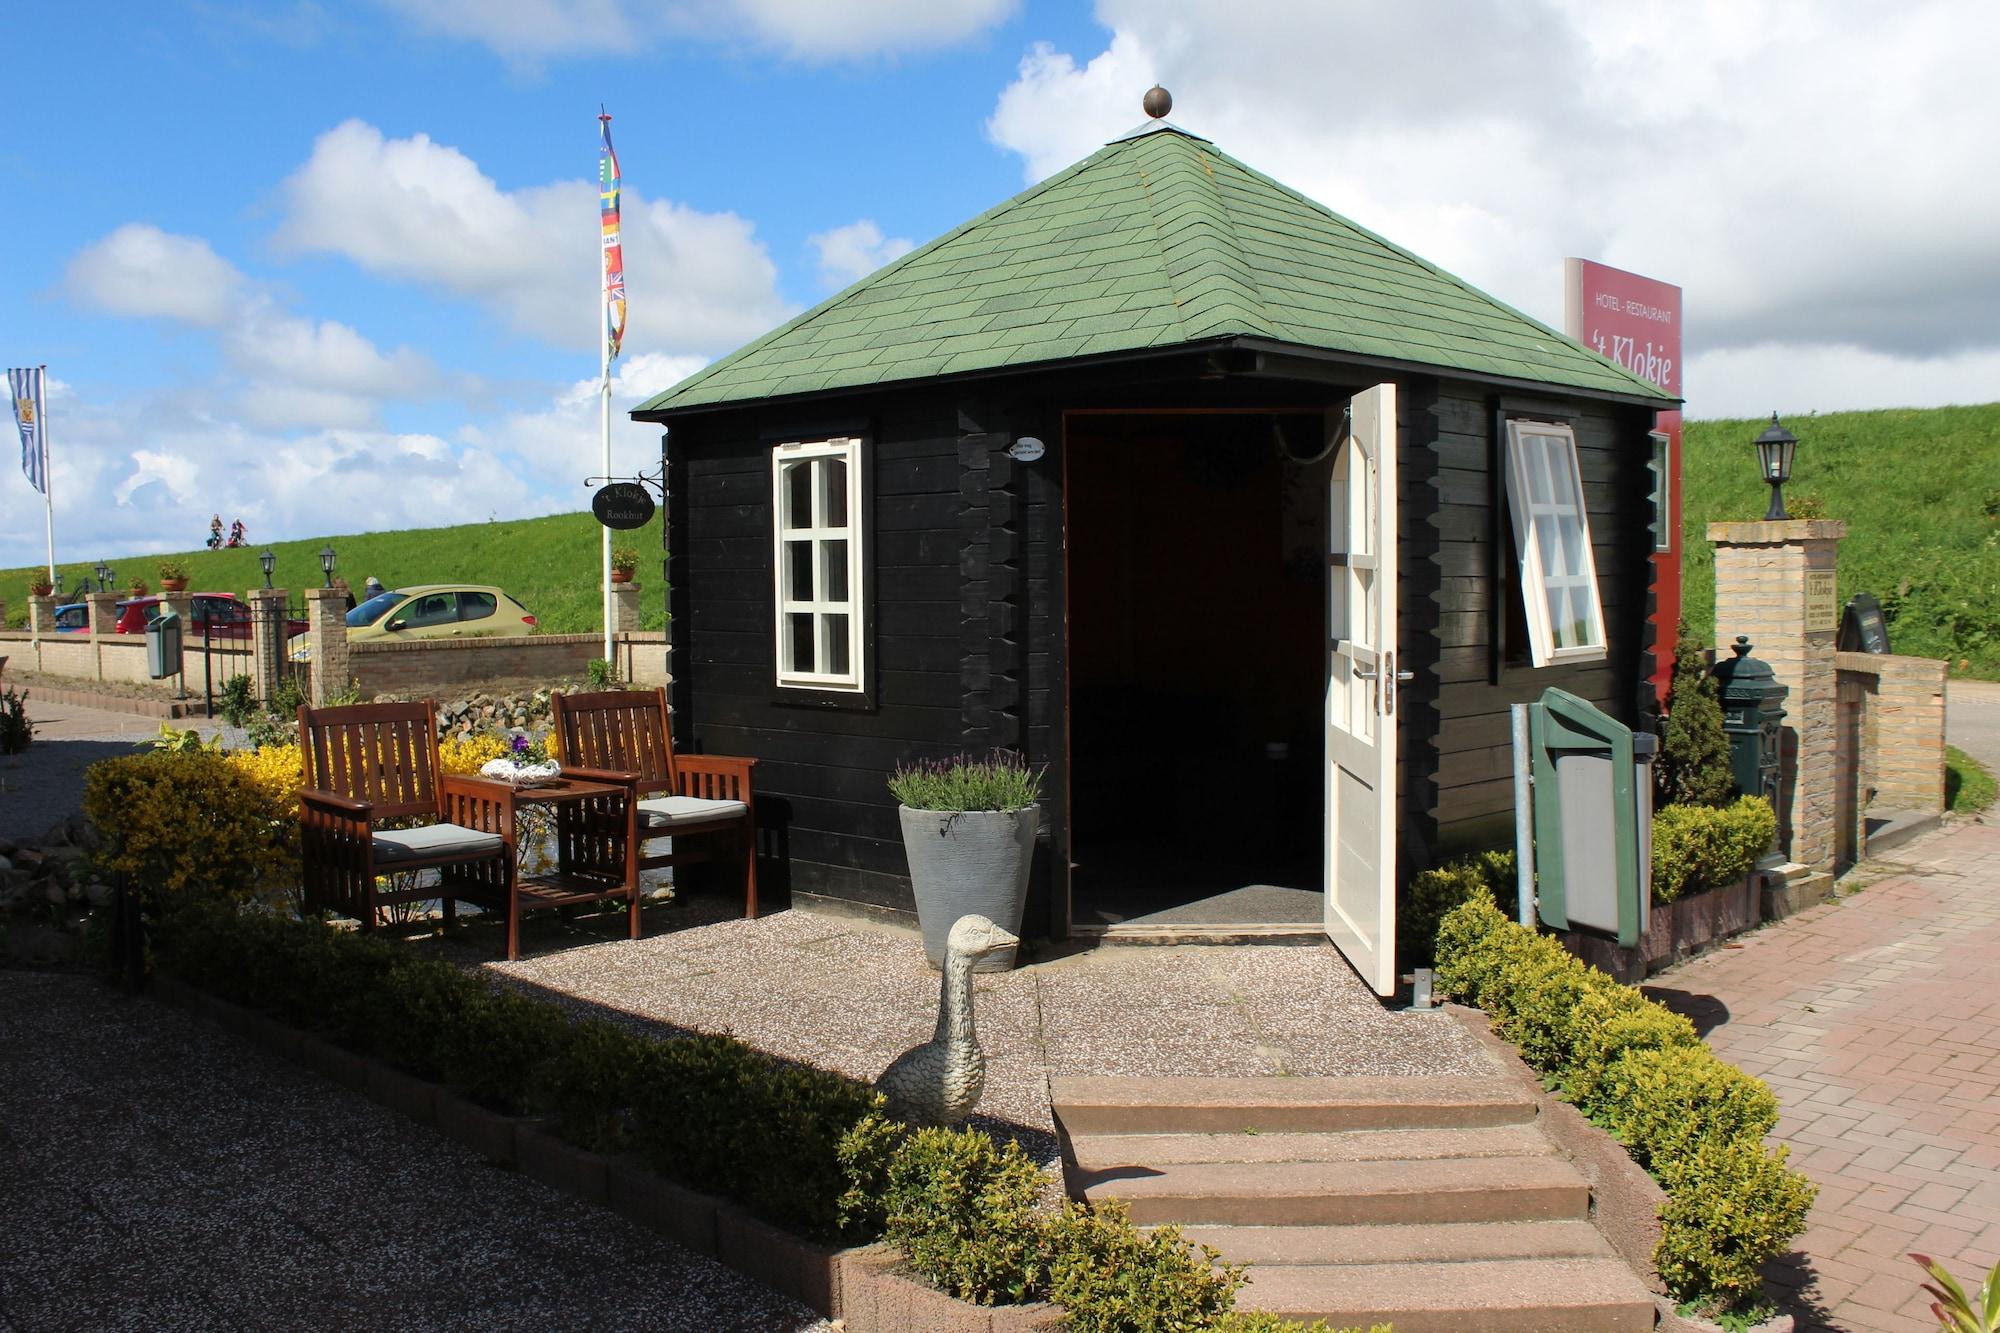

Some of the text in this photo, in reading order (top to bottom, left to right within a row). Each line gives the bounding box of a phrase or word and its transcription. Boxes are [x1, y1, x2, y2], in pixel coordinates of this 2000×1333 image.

[1595, 291, 1620, 312] HOTEL
[1626, 300, 1672, 324] RESTAURANT
[1612, 335, 1672, 386] Klokje
[607, 509, 643, 520] Rookhut
